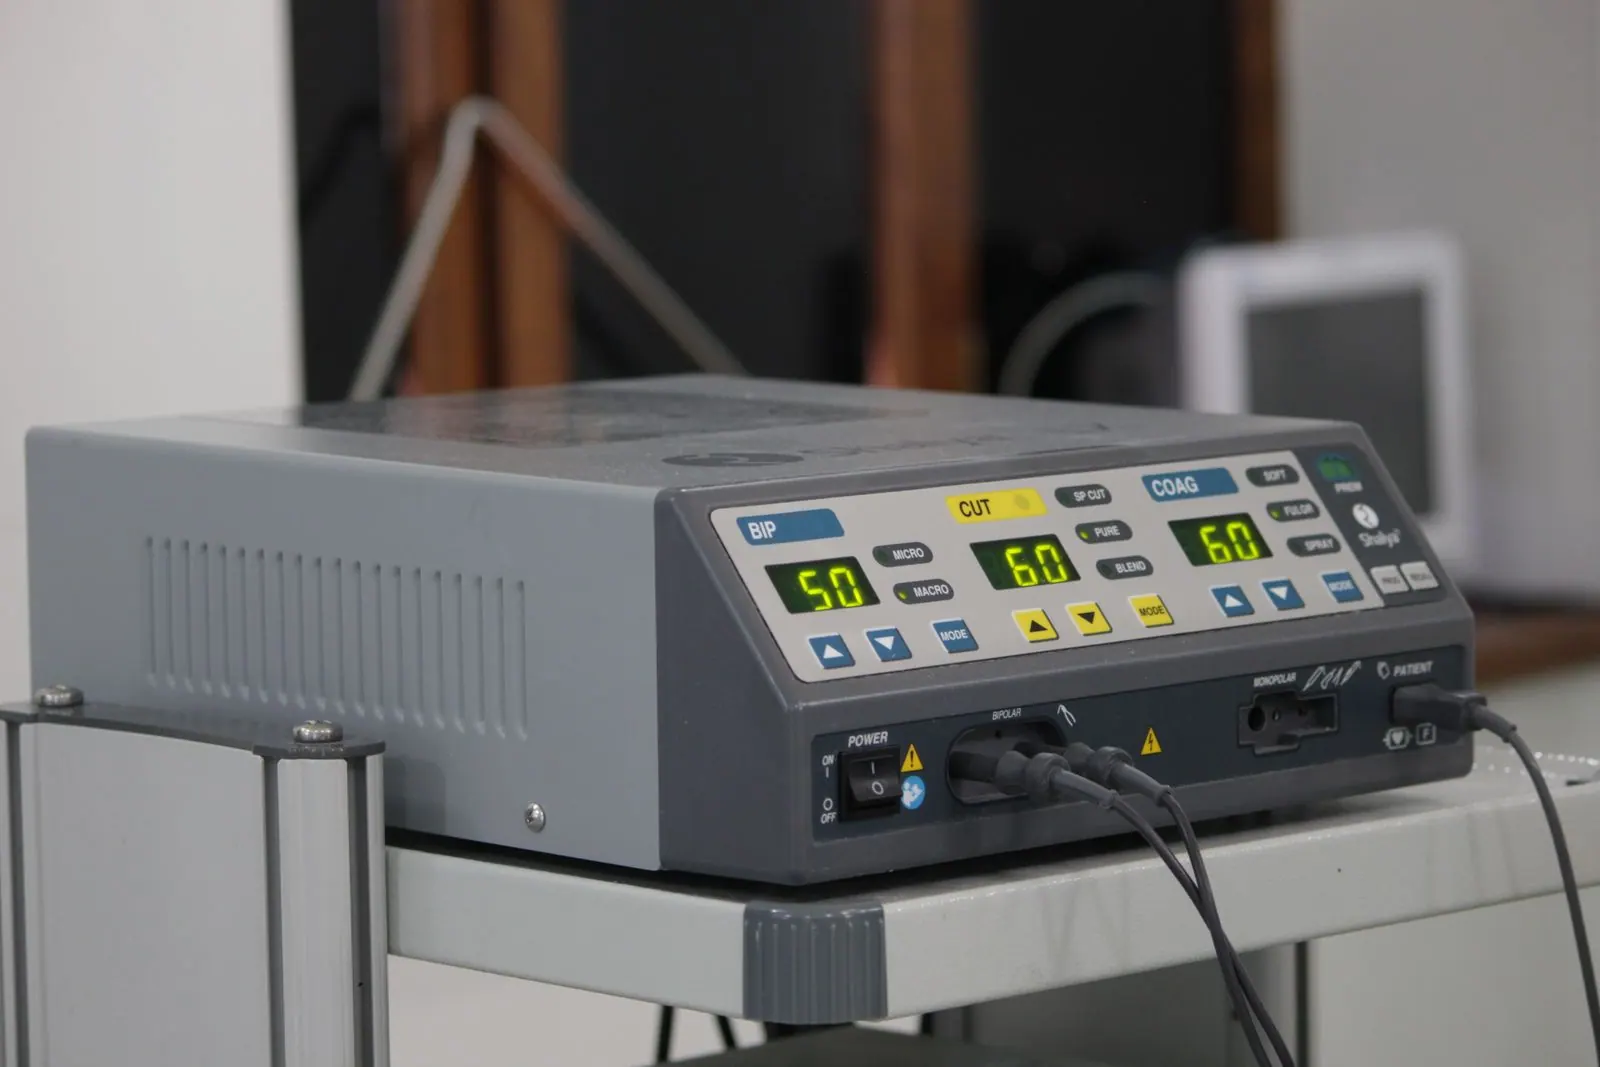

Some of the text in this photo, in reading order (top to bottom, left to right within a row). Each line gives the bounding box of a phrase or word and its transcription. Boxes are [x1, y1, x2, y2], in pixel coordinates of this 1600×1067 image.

[1263, 469, 1286, 481] SOFT
[1151, 477, 1199, 496] COAG
[1073, 489, 1106, 502] SP CUT
[959, 499, 992, 517] CUT
[748, 521, 776, 539] BIP
[1094, 525, 1120, 538] PURE
[1199, 521, 1259, 565] 60
[1304, 538, 1334, 551] SPRAY
[893, 548, 924, 560] MICRO
[1004, 543, 1067, 587] 60
[1115, 561, 1146, 573] BLEND
[799, 566, 863, 611] 50
[913, 585, 949, 597] MACRO
[1139, 605, 1165, 617] MODE
[940, 629, 968, 641] MODE
[1394, 661, 1434, 676] PATIENT
[1253, 672, 1297, 687] MONOPOLAR
[992, 707, 1022, 720] BIPOLAR
[848, 731, 889, 747] POWER
[822, 755, 835, 766] ON
[820, 812, 836, 824] OFF
